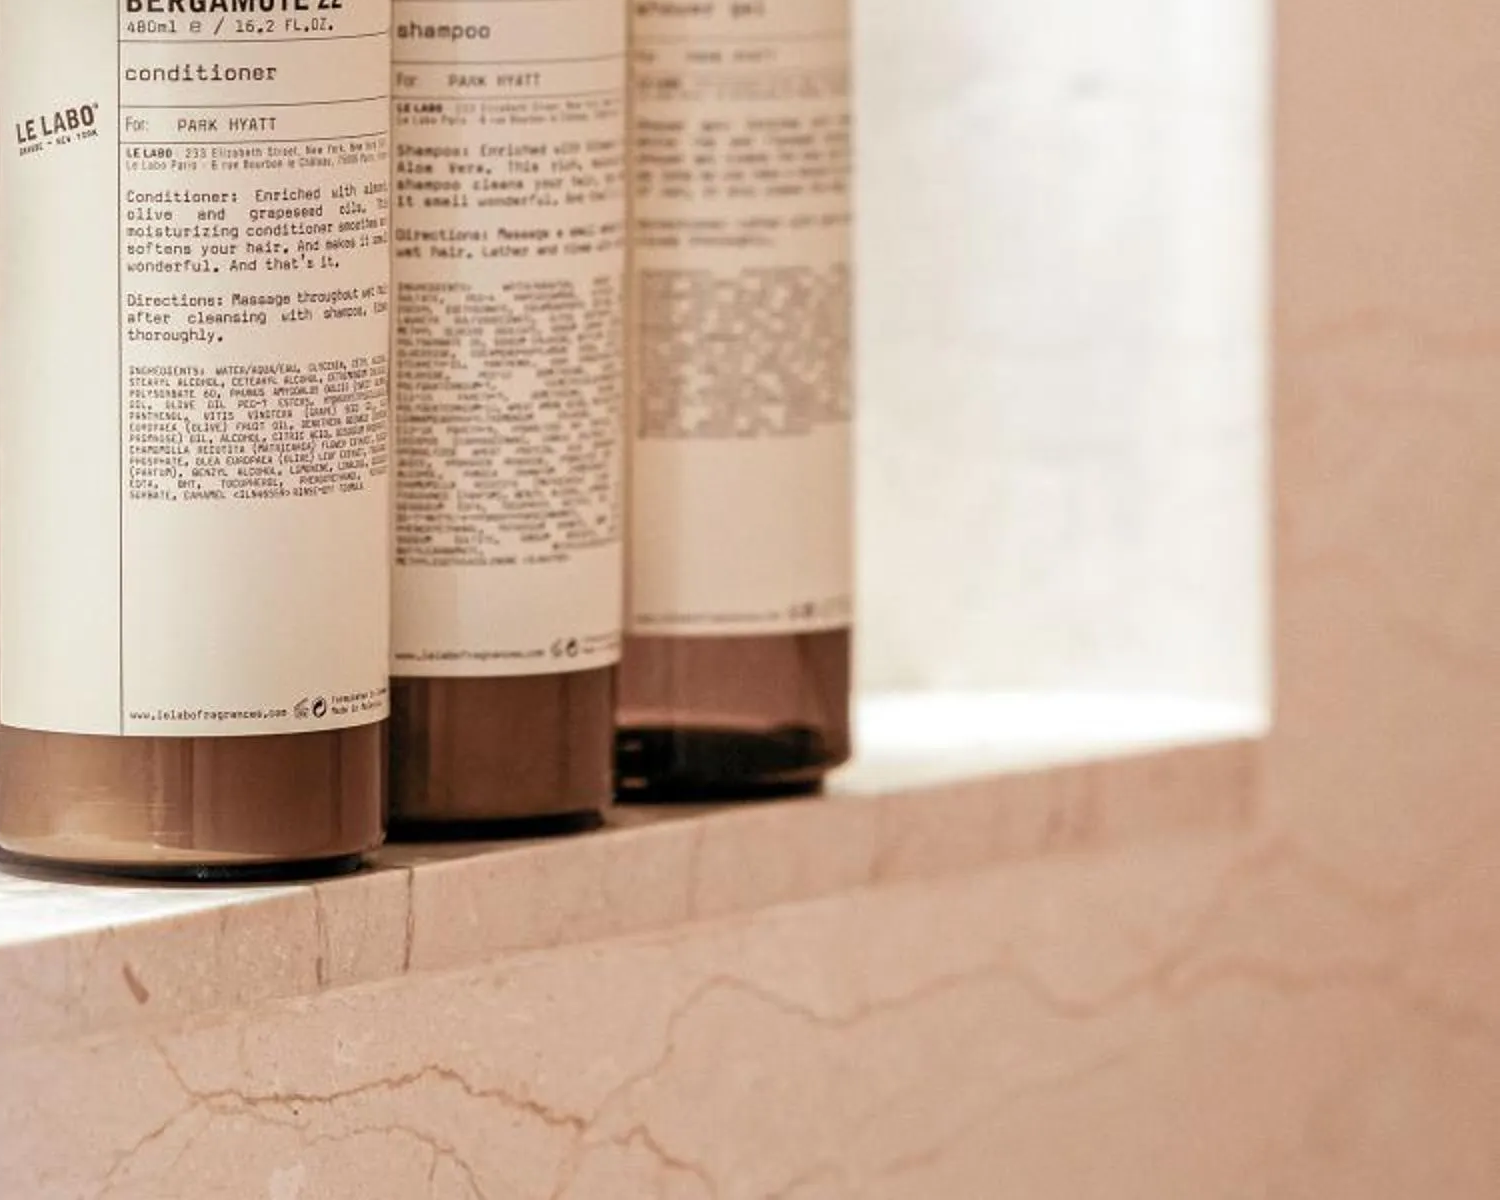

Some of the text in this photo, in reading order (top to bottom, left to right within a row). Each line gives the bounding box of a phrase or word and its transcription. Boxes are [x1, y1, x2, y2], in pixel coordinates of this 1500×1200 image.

[126, 19, 176, 33] 480ml
[235, 19, 275, 33] 16.2
[284, 17, 334, 33] FL.OZ.
[396, 20, 491, 42] shampoo
[125, 63, 277, 82] conditioner
[448, 73, 487, 87] PARK
[496, 72, 541, 87] HYATT
[16, 119, 37, 144] LE
[176, 117, 218, 132] PARK
[229, 117, 277, 132] HYATT
[125, 147, 140, 159] LE
[143, 147, 173, 159] LABO
[126, 189, 238, 203] Conditioner:
[255, 187, 321, 203] Enriched
[126, 208, 173, 221] olive
[197, 208, 226, 221] and
[249, 204, 323, 222] grapeseed
[126, 225, 239, 240] moisturizing
[246, 222, 333, 238] conditioner
[127, 242, 192, 255] softens
[201, 243, 237, 257] your
[246, 240, 289, 254] hair.
[297, 239, 319, 252] And
[127, 260, 219, 273] wonderful.
[229, 259, 257, 272] And
[265, 253, 314, 271] that's
[127, 293, 224, 307] Directions:
[231, 293, 291, 307] Massage
[127, 311, 171, 324] after
[187, 311, 267, 325] cleansing
[281, 308, 313, 321] with
[127, 328, 224, 344] thoroughly.
